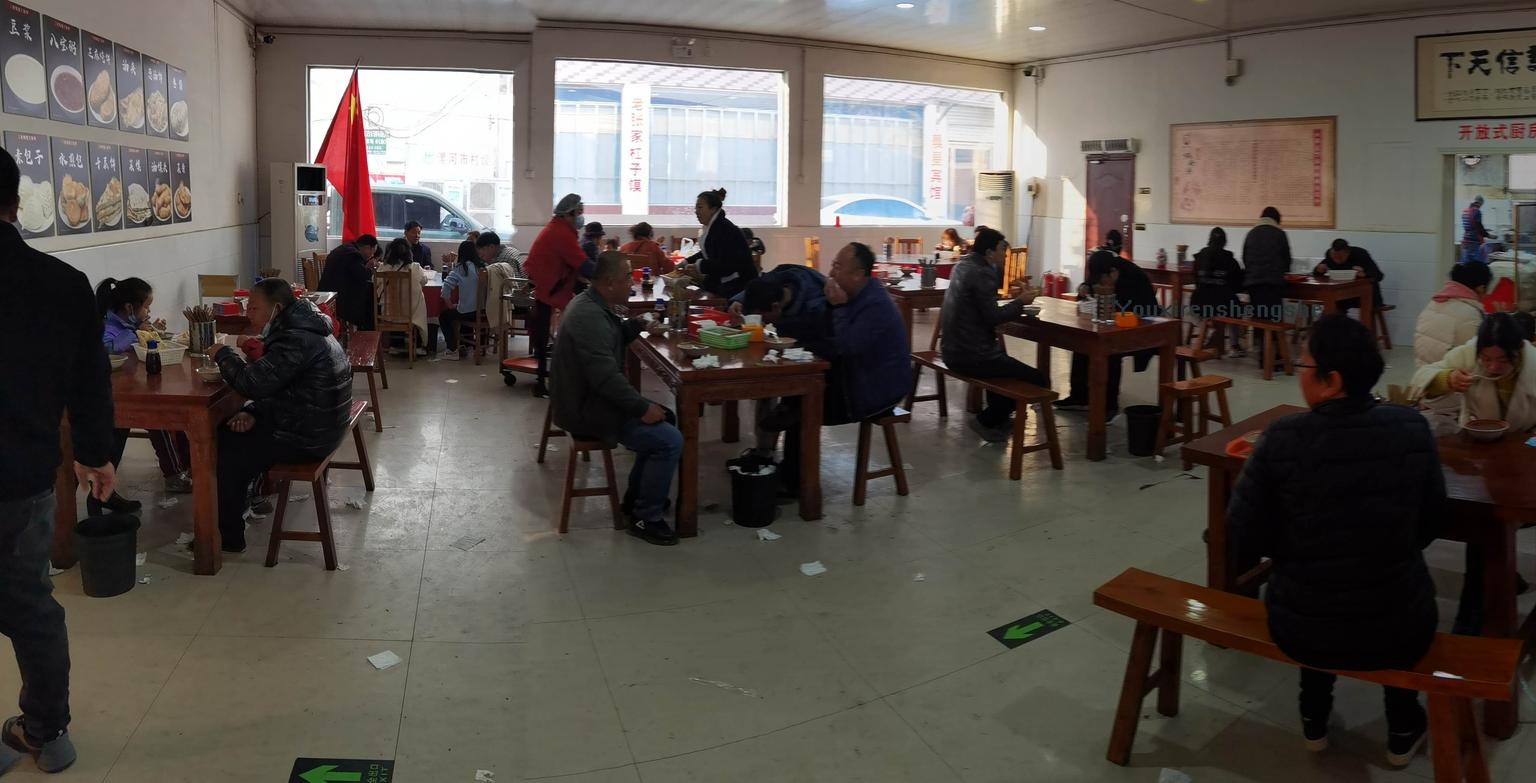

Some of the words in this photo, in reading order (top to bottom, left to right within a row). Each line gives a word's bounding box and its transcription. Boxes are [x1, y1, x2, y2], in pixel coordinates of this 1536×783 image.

[9, 18, 33, 42] 豆浆
[50, 33, 77, 56] 八宝粥
